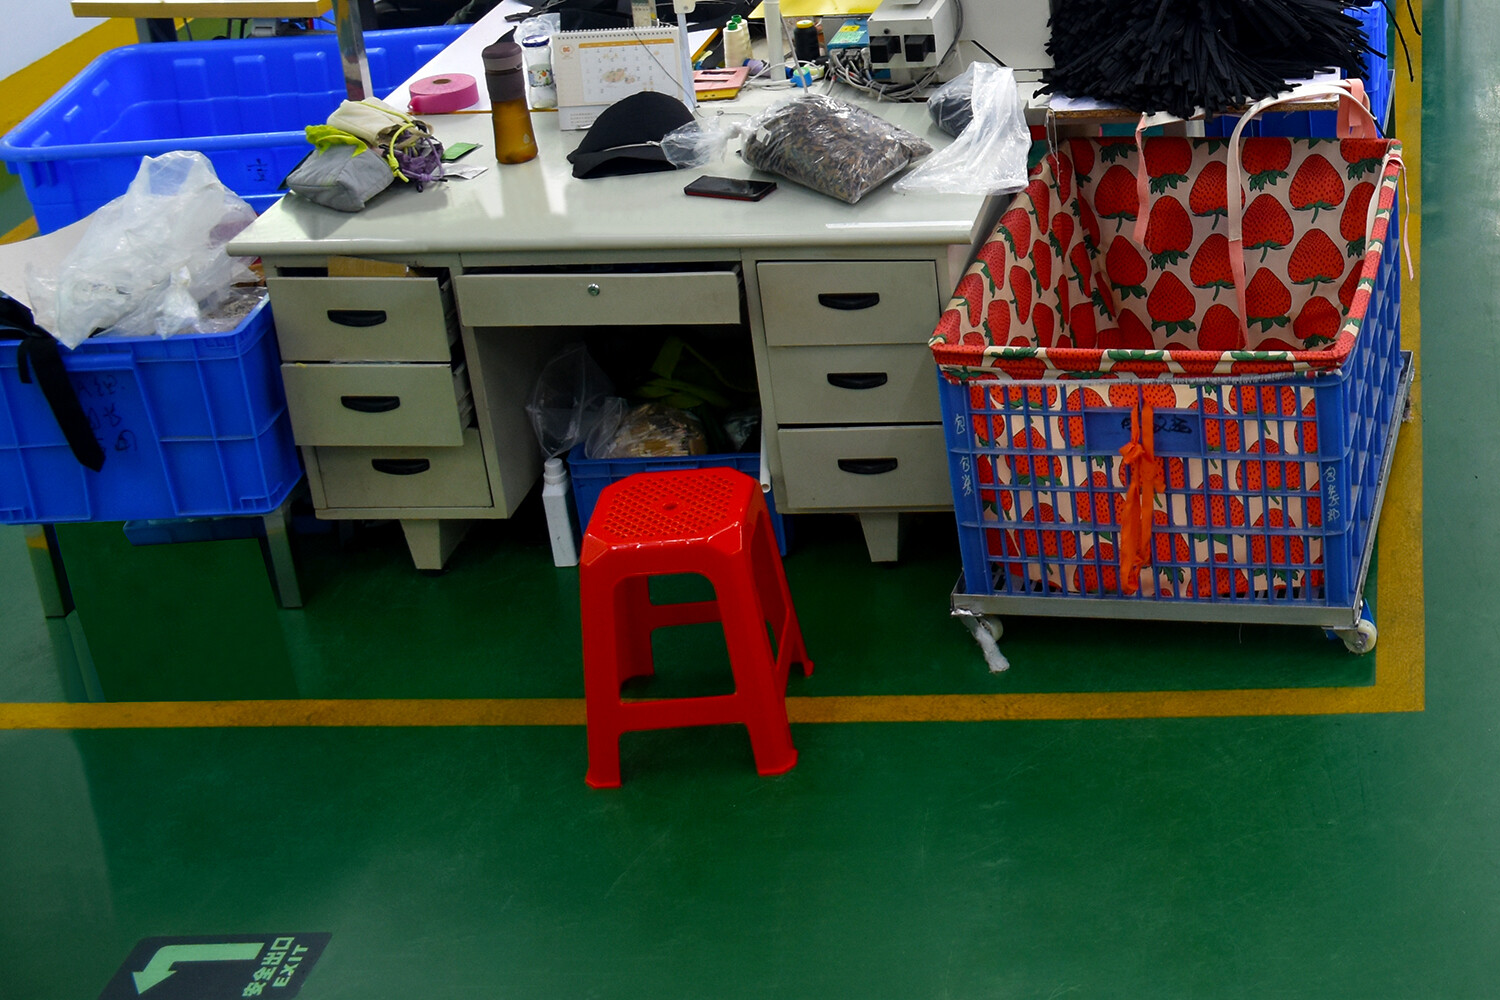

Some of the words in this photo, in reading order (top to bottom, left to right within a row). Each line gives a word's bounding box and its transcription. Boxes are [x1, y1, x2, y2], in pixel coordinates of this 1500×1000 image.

[241, 936, 295, 998] 安全出口
[272, 944, 309, 988] EXIT
